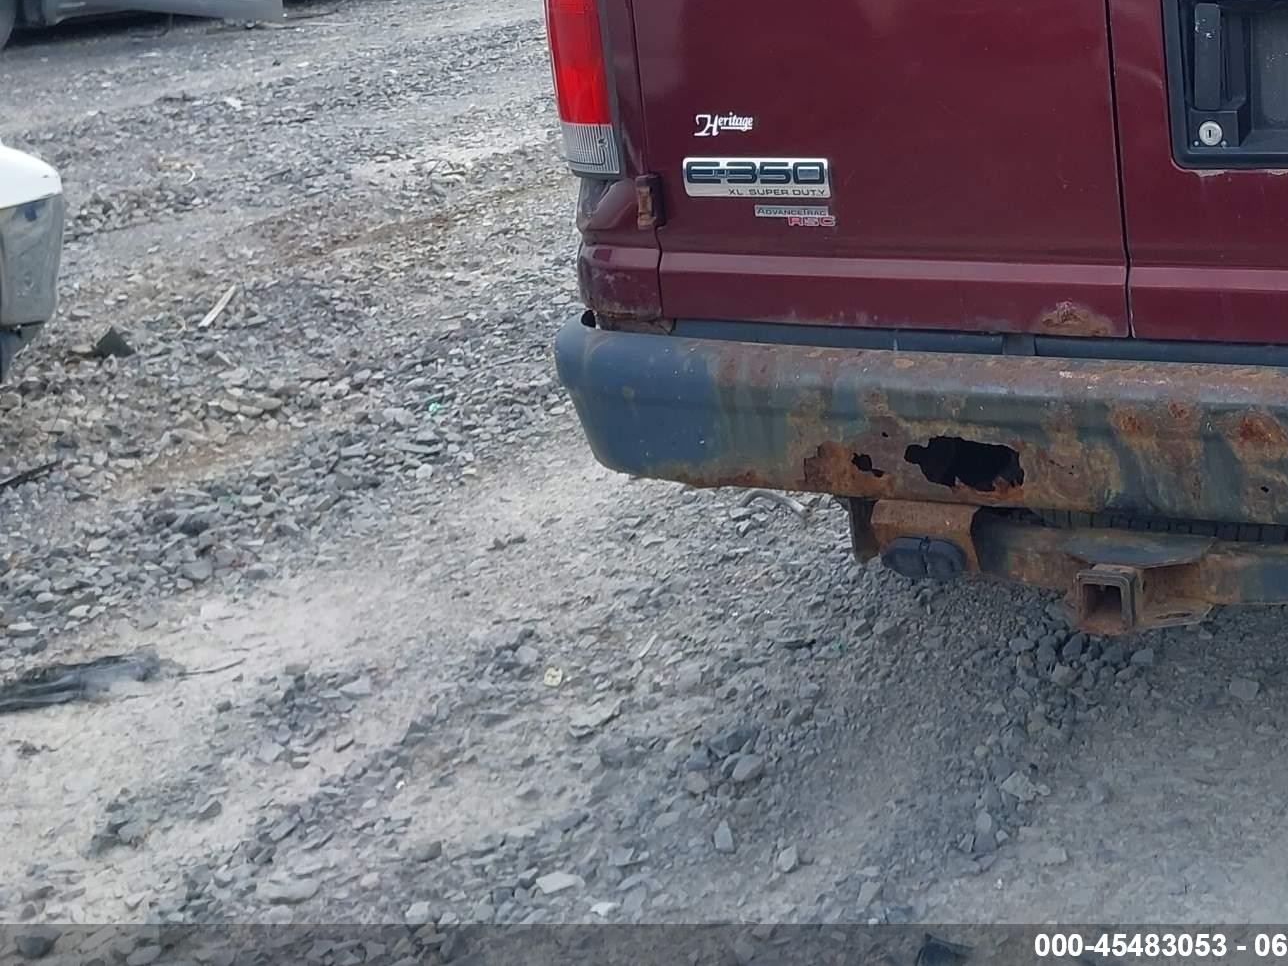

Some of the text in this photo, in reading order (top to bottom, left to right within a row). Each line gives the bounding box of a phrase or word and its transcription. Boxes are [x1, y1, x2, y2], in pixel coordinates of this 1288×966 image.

[694, 111, 753, 136] Heritage
[728, 188, 826, 197] XL SUPER DUTY
[788, 215, 836, 227] RSC
